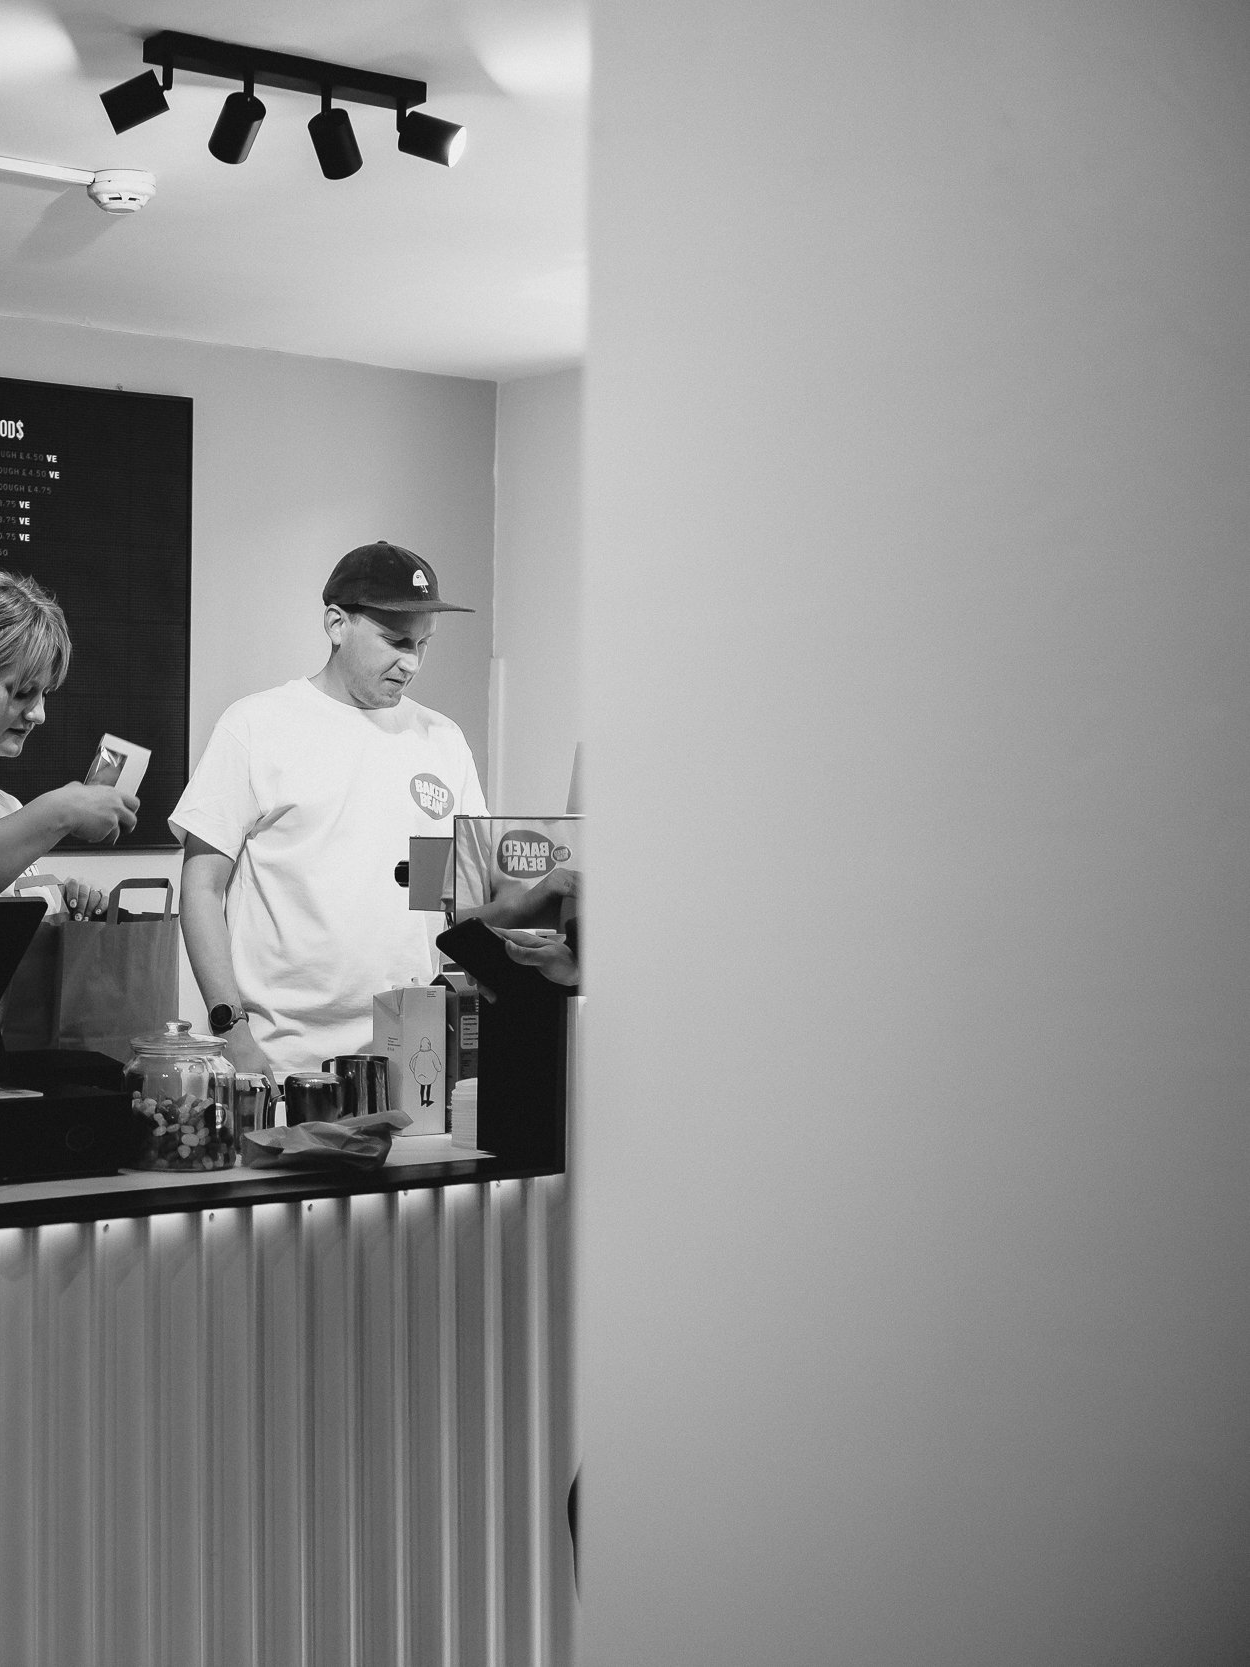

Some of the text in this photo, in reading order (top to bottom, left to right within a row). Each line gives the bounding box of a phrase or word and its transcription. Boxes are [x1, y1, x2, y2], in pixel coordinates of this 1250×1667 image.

[49, 471, 59, 479] VE
[19, 501, 30, 509] VE
[19, 517, 30, 525] VE
[415, 779, 449, 803] BAKED
[420, 792, 443, 816] BEAN
